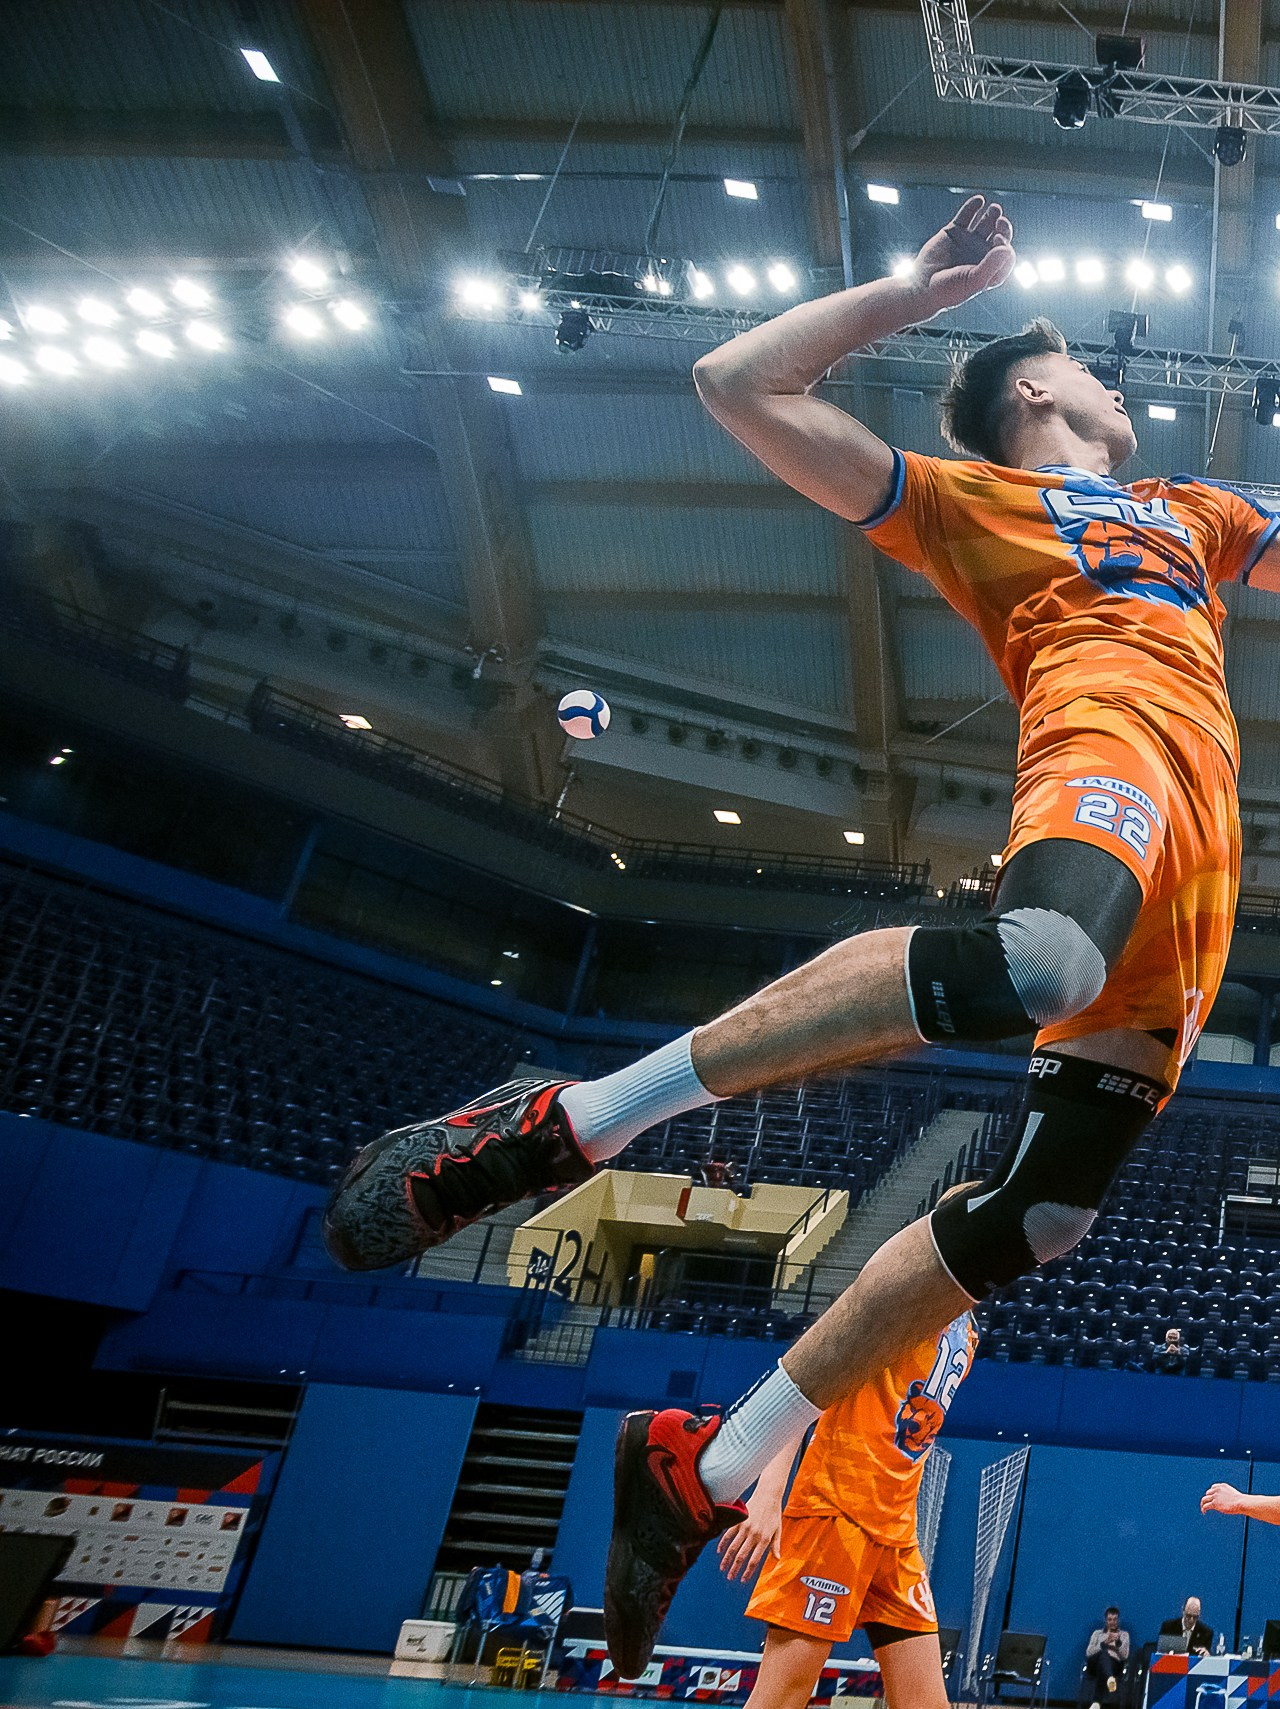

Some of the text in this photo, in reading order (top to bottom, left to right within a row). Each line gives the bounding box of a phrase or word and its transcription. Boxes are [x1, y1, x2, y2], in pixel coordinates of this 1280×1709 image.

[1075, 792, 1150, 860] 22
[923, 1333, 968, 1412] 12
[32, 1448, 104, 1468] РОССИИ
[803, 1592, 836, 1624] 12
